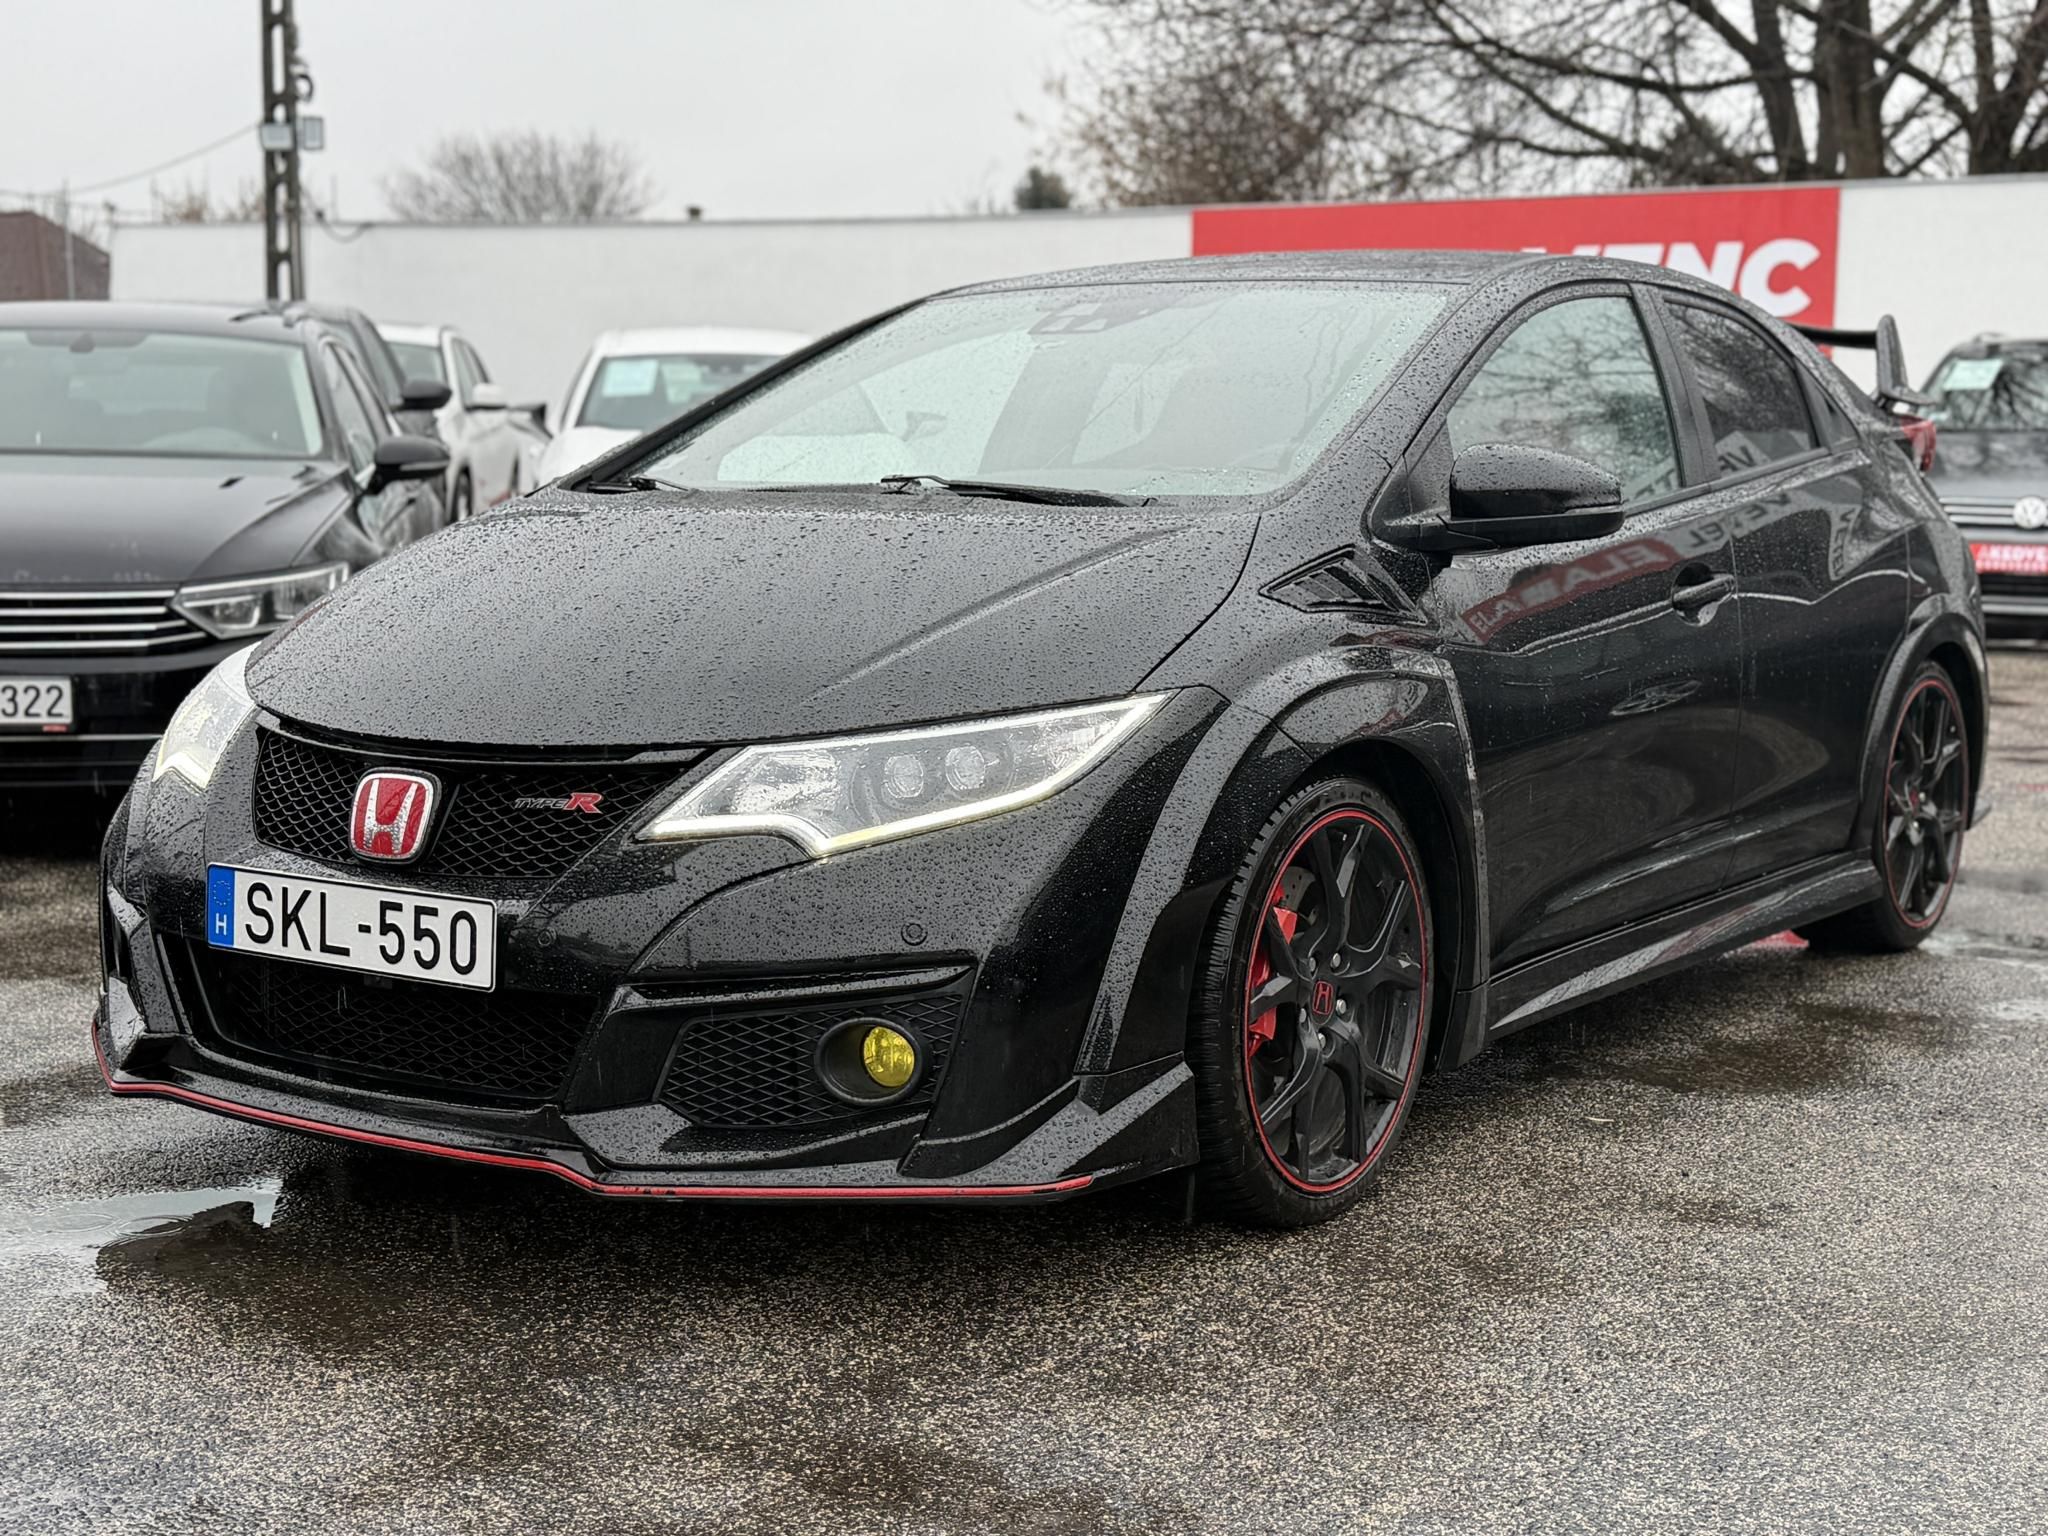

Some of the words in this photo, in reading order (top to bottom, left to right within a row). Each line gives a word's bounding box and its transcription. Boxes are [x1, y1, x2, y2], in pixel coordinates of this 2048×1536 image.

[1, 685, 64, 718] 322
[215, 913, 227, 936] H
[245, 882, 477, 975] SKL-550
